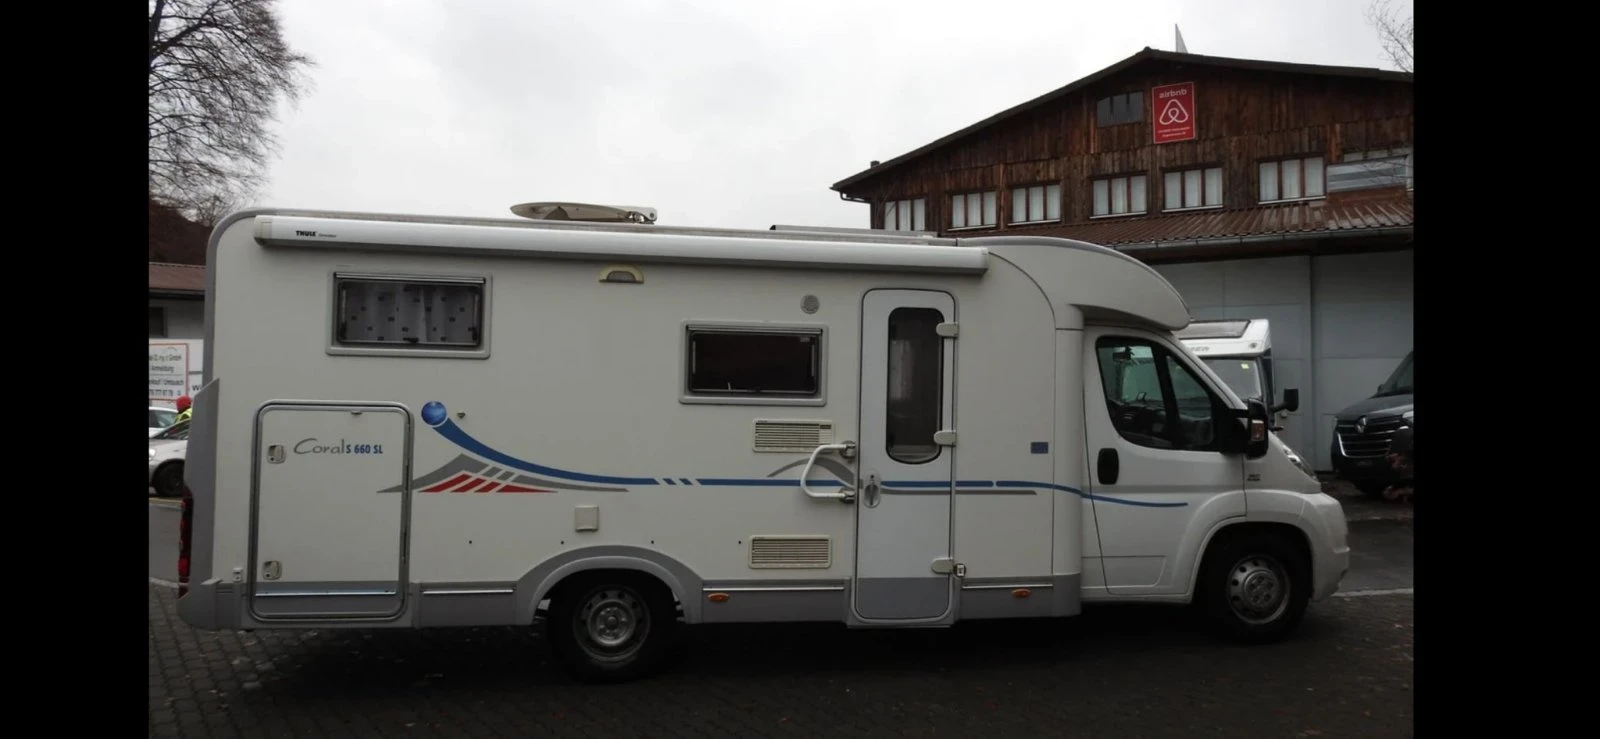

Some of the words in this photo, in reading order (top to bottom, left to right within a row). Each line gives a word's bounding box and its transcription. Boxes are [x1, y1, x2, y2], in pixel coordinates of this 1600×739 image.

[1159, 88, 1188, 99] airbnb
[293, 438, 345, 455] Coral
[345, 444, 352, 454] S
[354, 444, 371, 454] 660
[373, 444, 384, 455] SL
